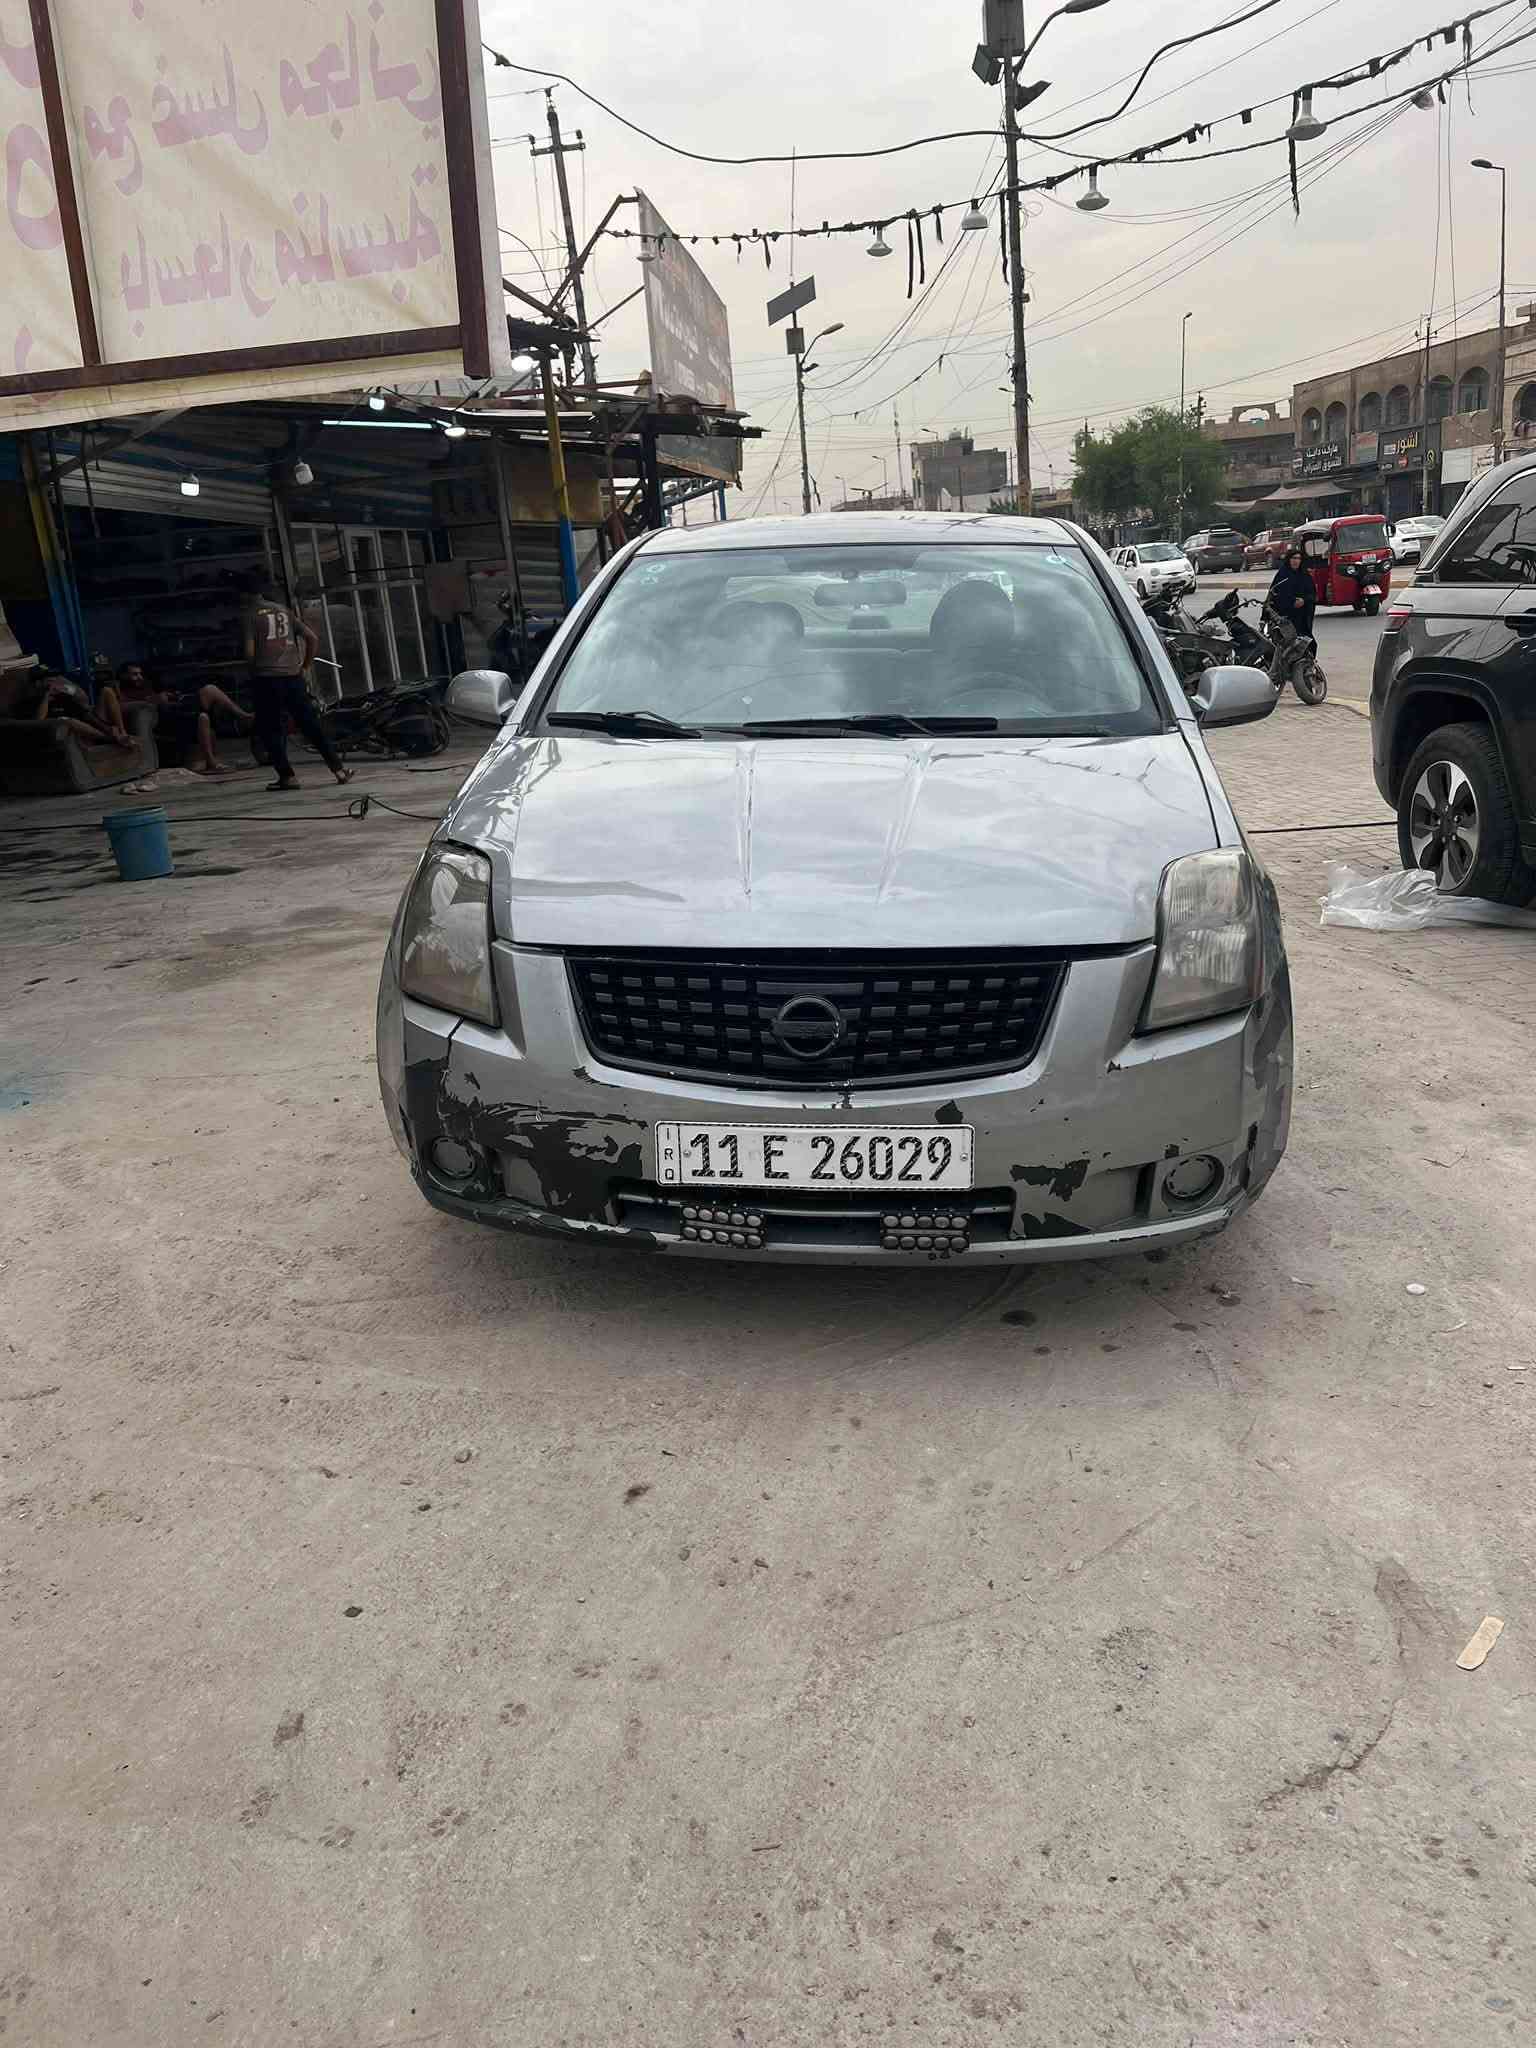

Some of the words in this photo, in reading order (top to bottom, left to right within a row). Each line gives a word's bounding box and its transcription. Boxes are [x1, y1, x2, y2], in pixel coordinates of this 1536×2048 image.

[266, 612, 289, 640] 13
[690, 1133, 744, 1178] 11
[763, 1135, 790, 1180] E
[810, 1135, 952, 1182] 26029
